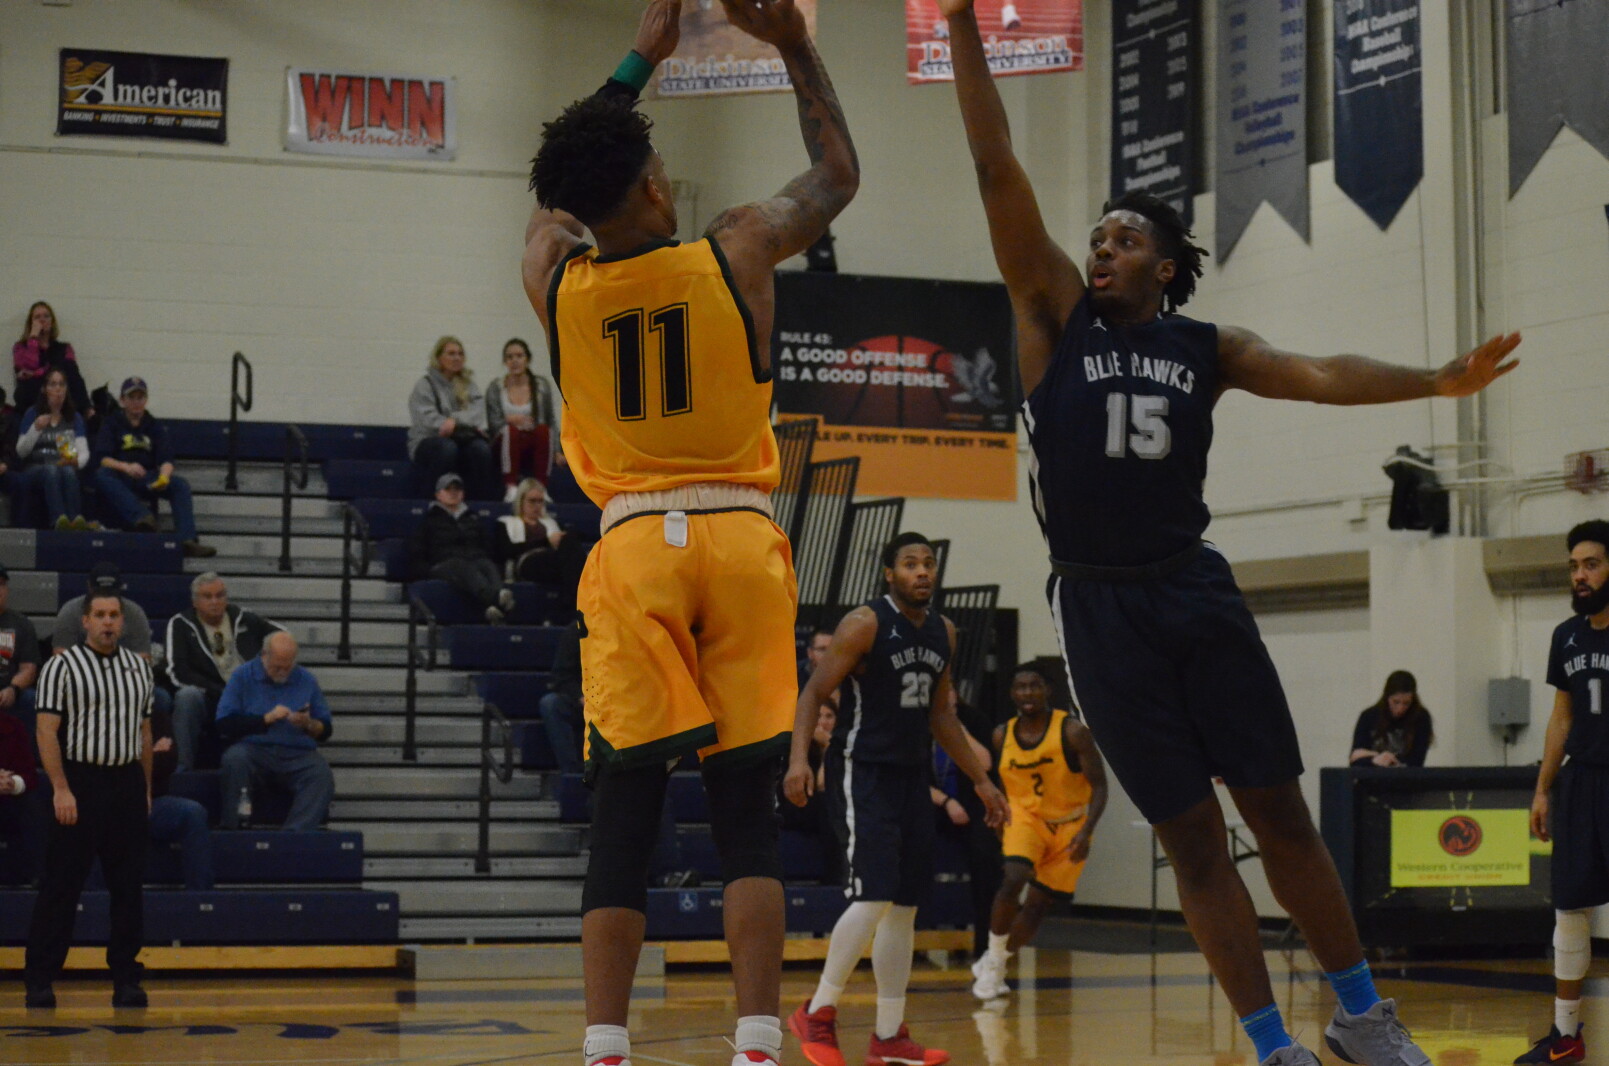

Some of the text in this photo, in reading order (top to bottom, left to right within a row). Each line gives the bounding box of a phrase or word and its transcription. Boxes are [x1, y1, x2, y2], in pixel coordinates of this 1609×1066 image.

[925, 35, 1067, 64] Dinson
[664, 54, 788, 80] Dickinso
[74, 66, 222, 110] American
[709, 71, 793, 88] UNIVERSIT
[63, 111, 220, 130] BANKING INVESTMENTS TRUST INSURANCE
[299, 72, 445, 149] WINN
[780, 331, 812, 344] RULE
[602, 301, 693, 422] 11
[780, 346, 928, 368] A GOOD OFFENSE
[780, 366, 950, 389] IS A GOOD DEFENSE.
[1130, 352, 1196, 395] HAWKS
[1104, 391, 1172, 460] 15
[856, 432, 899, 444] EVERY
[934, 436, 974, 448] EVERY
[890, 646, 916, 670] BLUE
[1563, 653, 1587, 677] BLUE
[900, 671, 933, 708] 23
[1031, 772, 1043, 797] 2
[1397, 863, 1448, 872] Western
